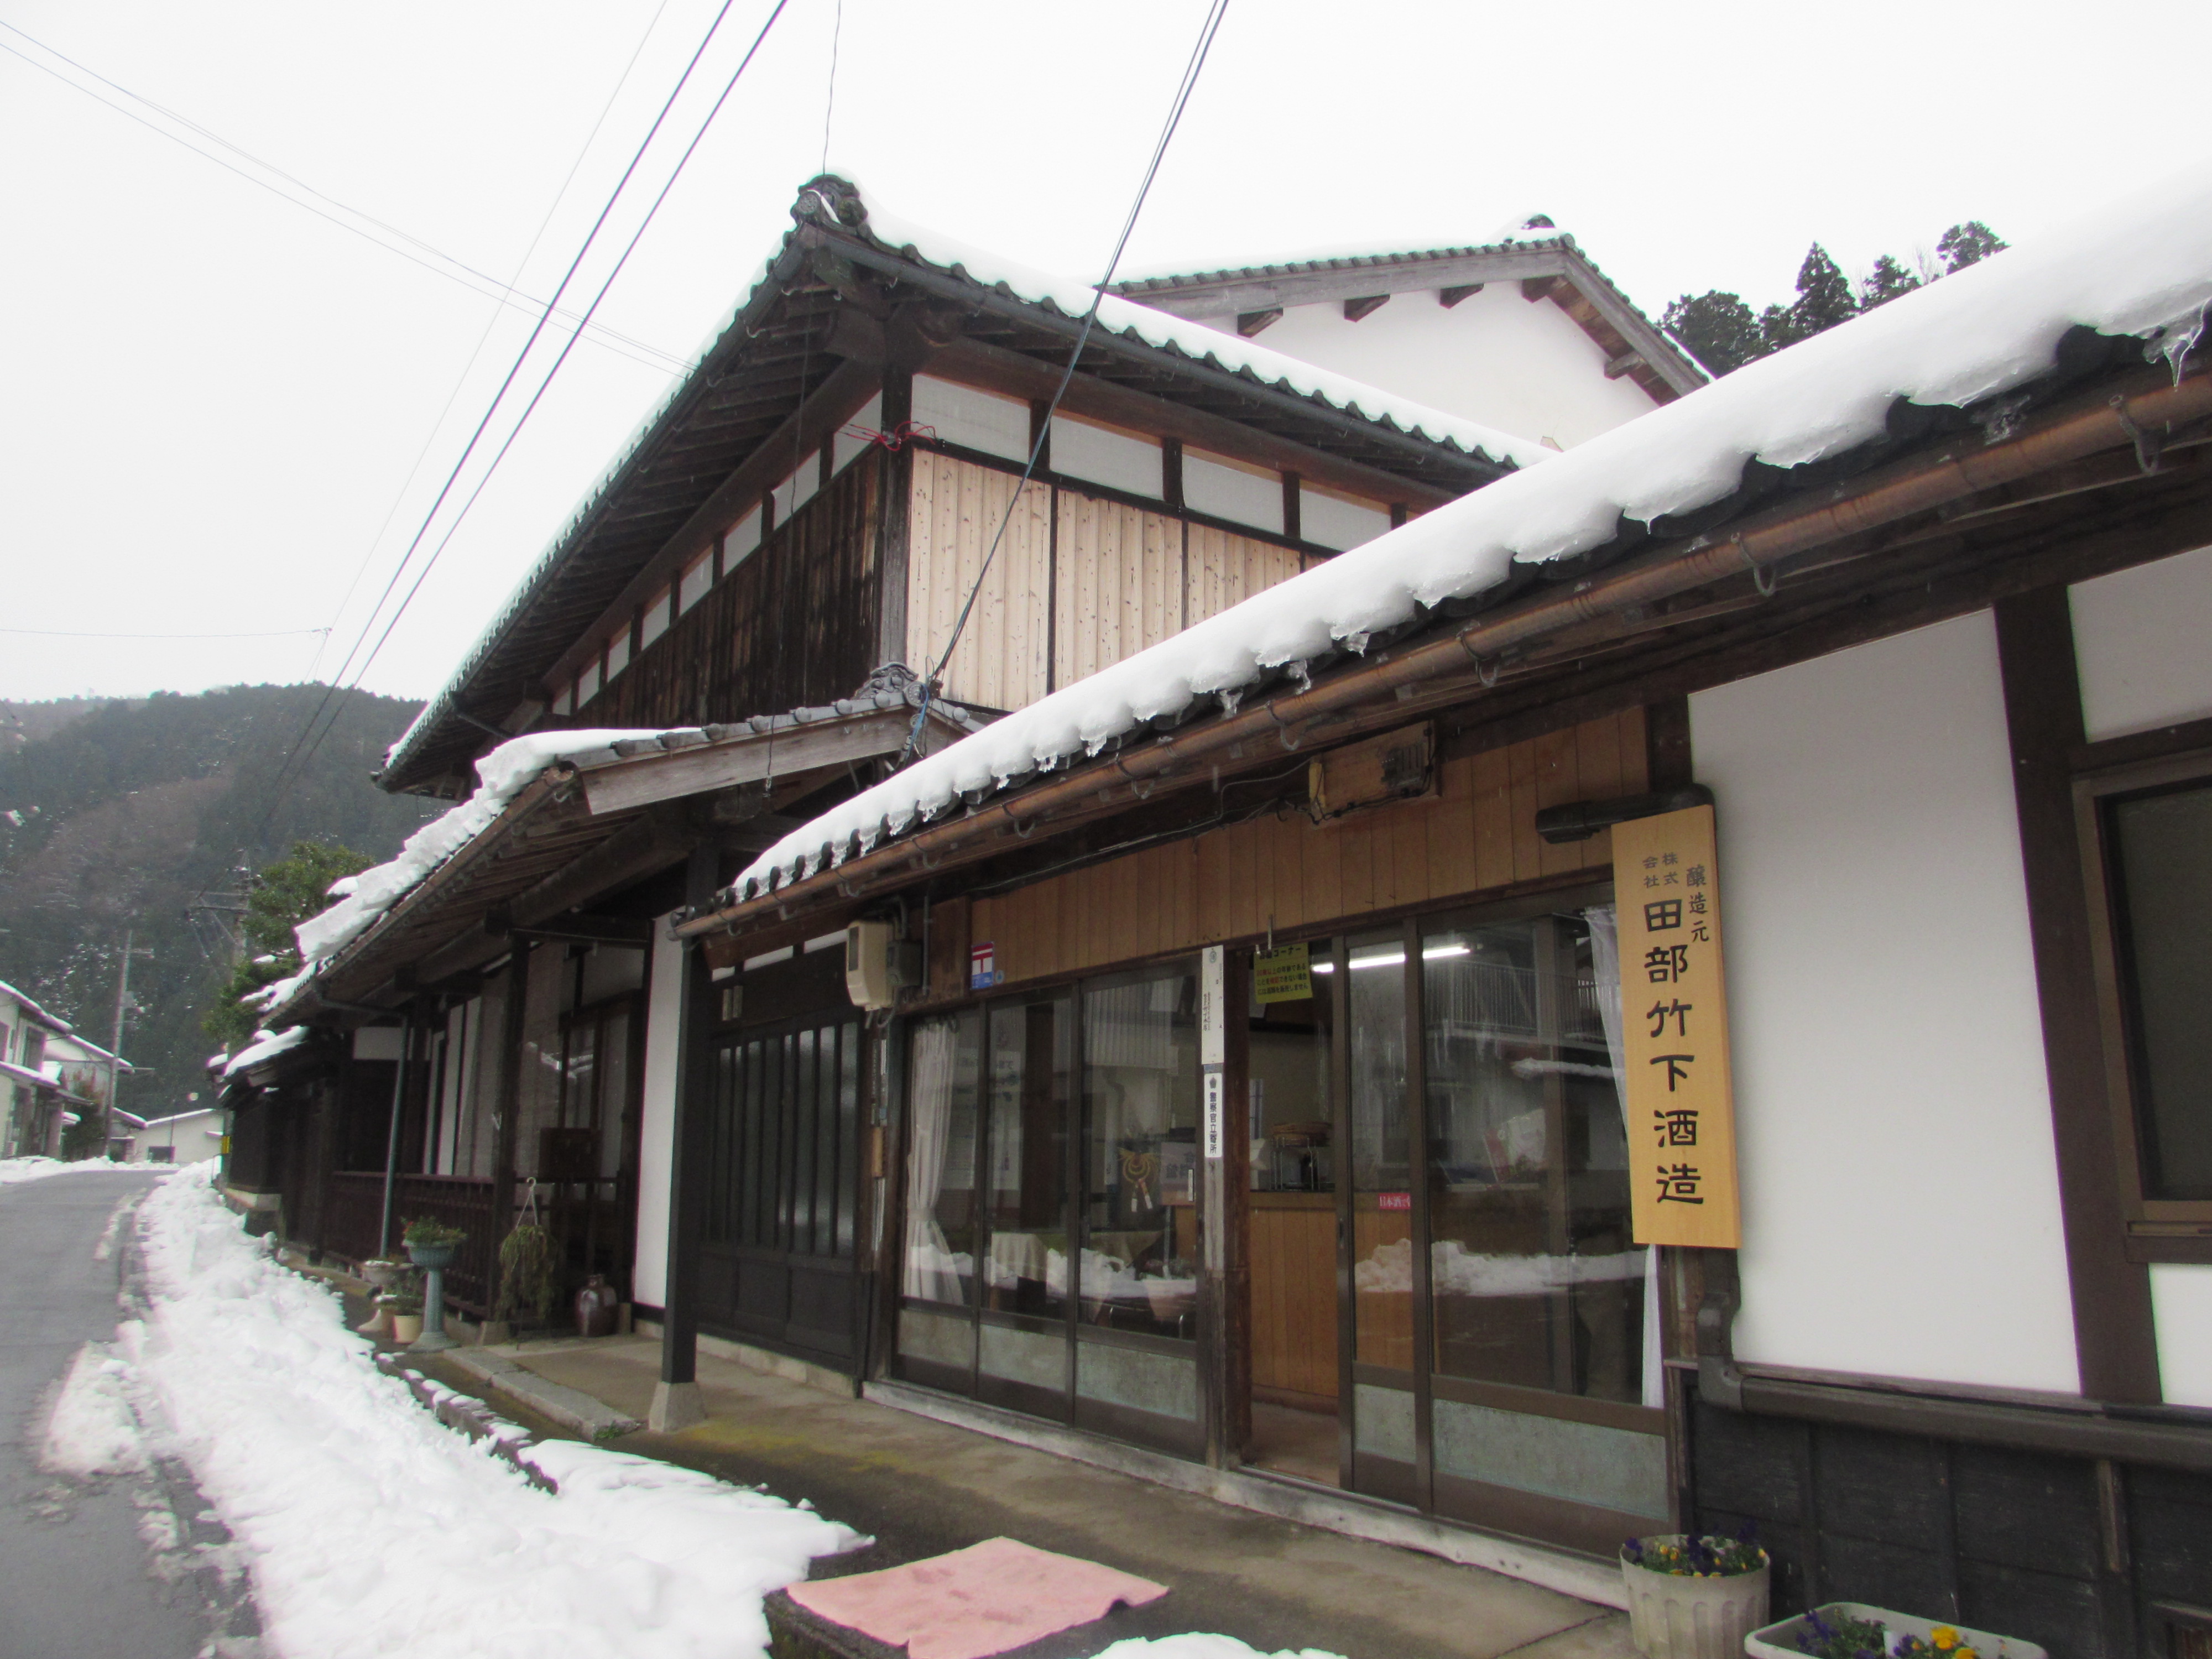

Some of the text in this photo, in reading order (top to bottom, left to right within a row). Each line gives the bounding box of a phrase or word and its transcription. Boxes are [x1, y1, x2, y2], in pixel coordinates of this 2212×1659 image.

[1644, 899, 1704, 1204] 田部竹下酒造
